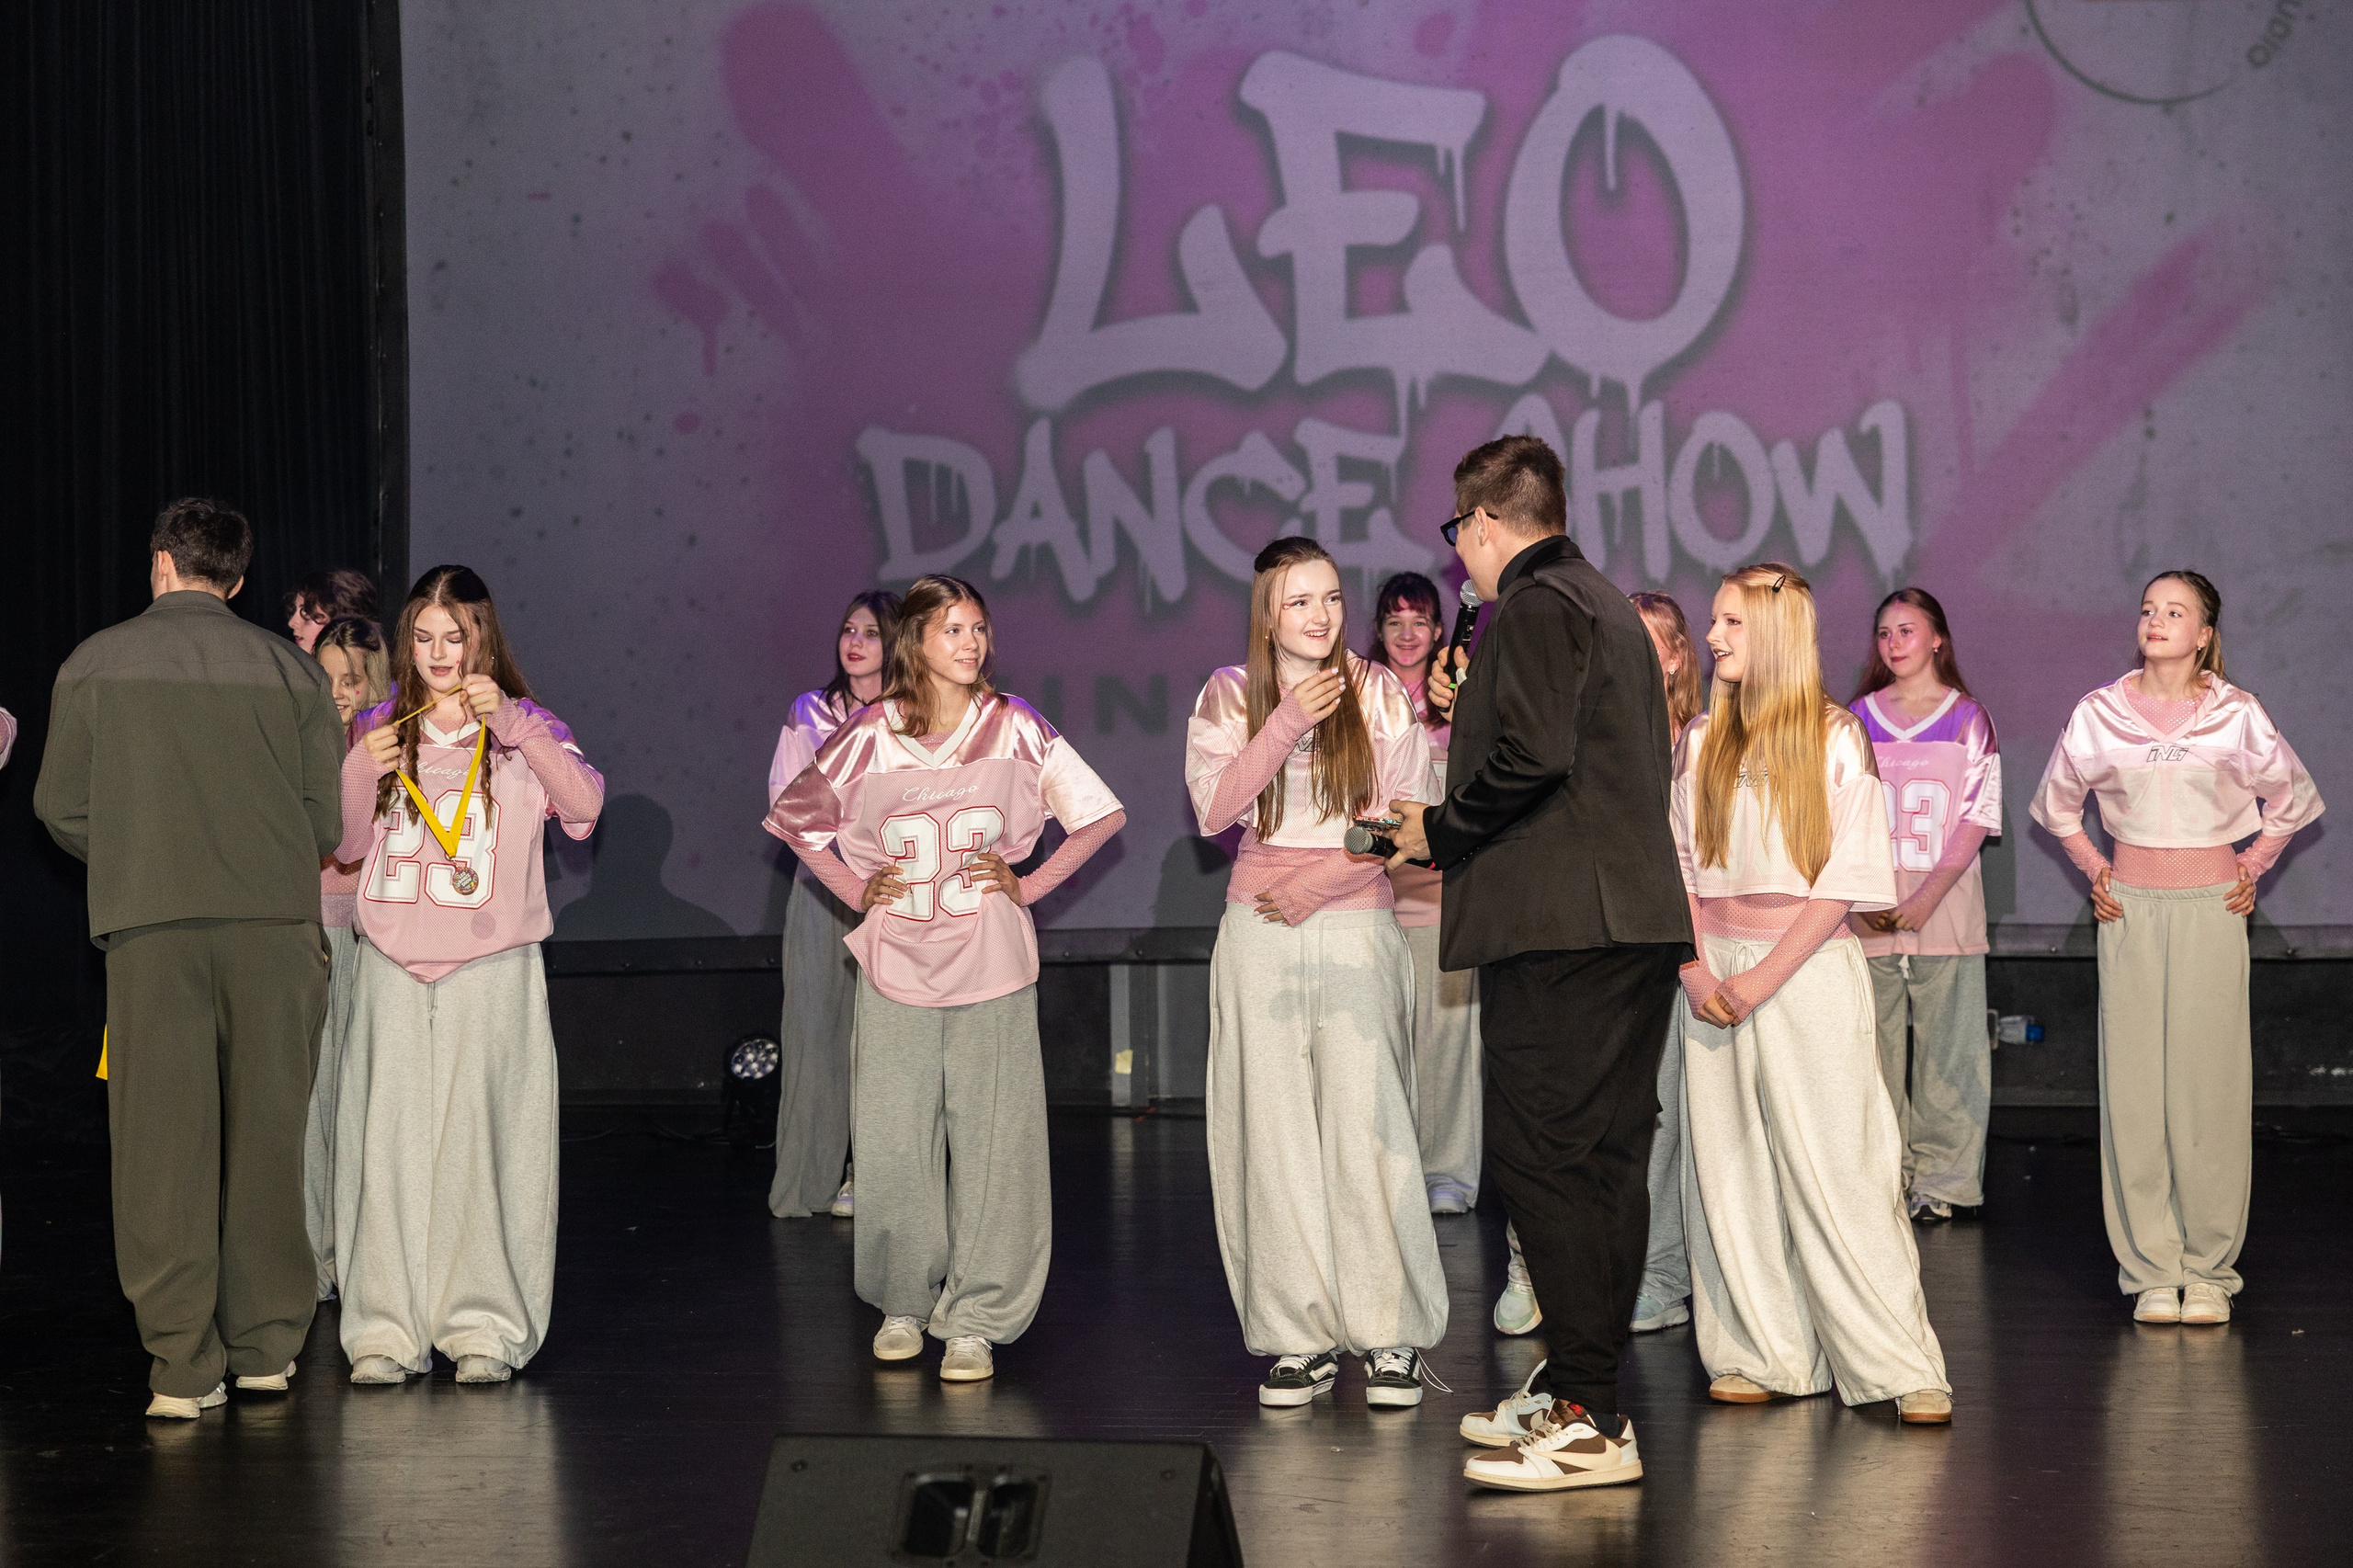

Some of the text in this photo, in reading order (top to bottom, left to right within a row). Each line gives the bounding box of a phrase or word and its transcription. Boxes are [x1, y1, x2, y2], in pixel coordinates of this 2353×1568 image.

[1015, 34, 1745, 411] LEO
[856, 417, 1436, 603] DANCE
[399, 761, 471, 780] hicag
[902, 784, 979, 802] Chicago
[364, 785, 501, 909] 23
[879, 805, 1006, 922] 23
